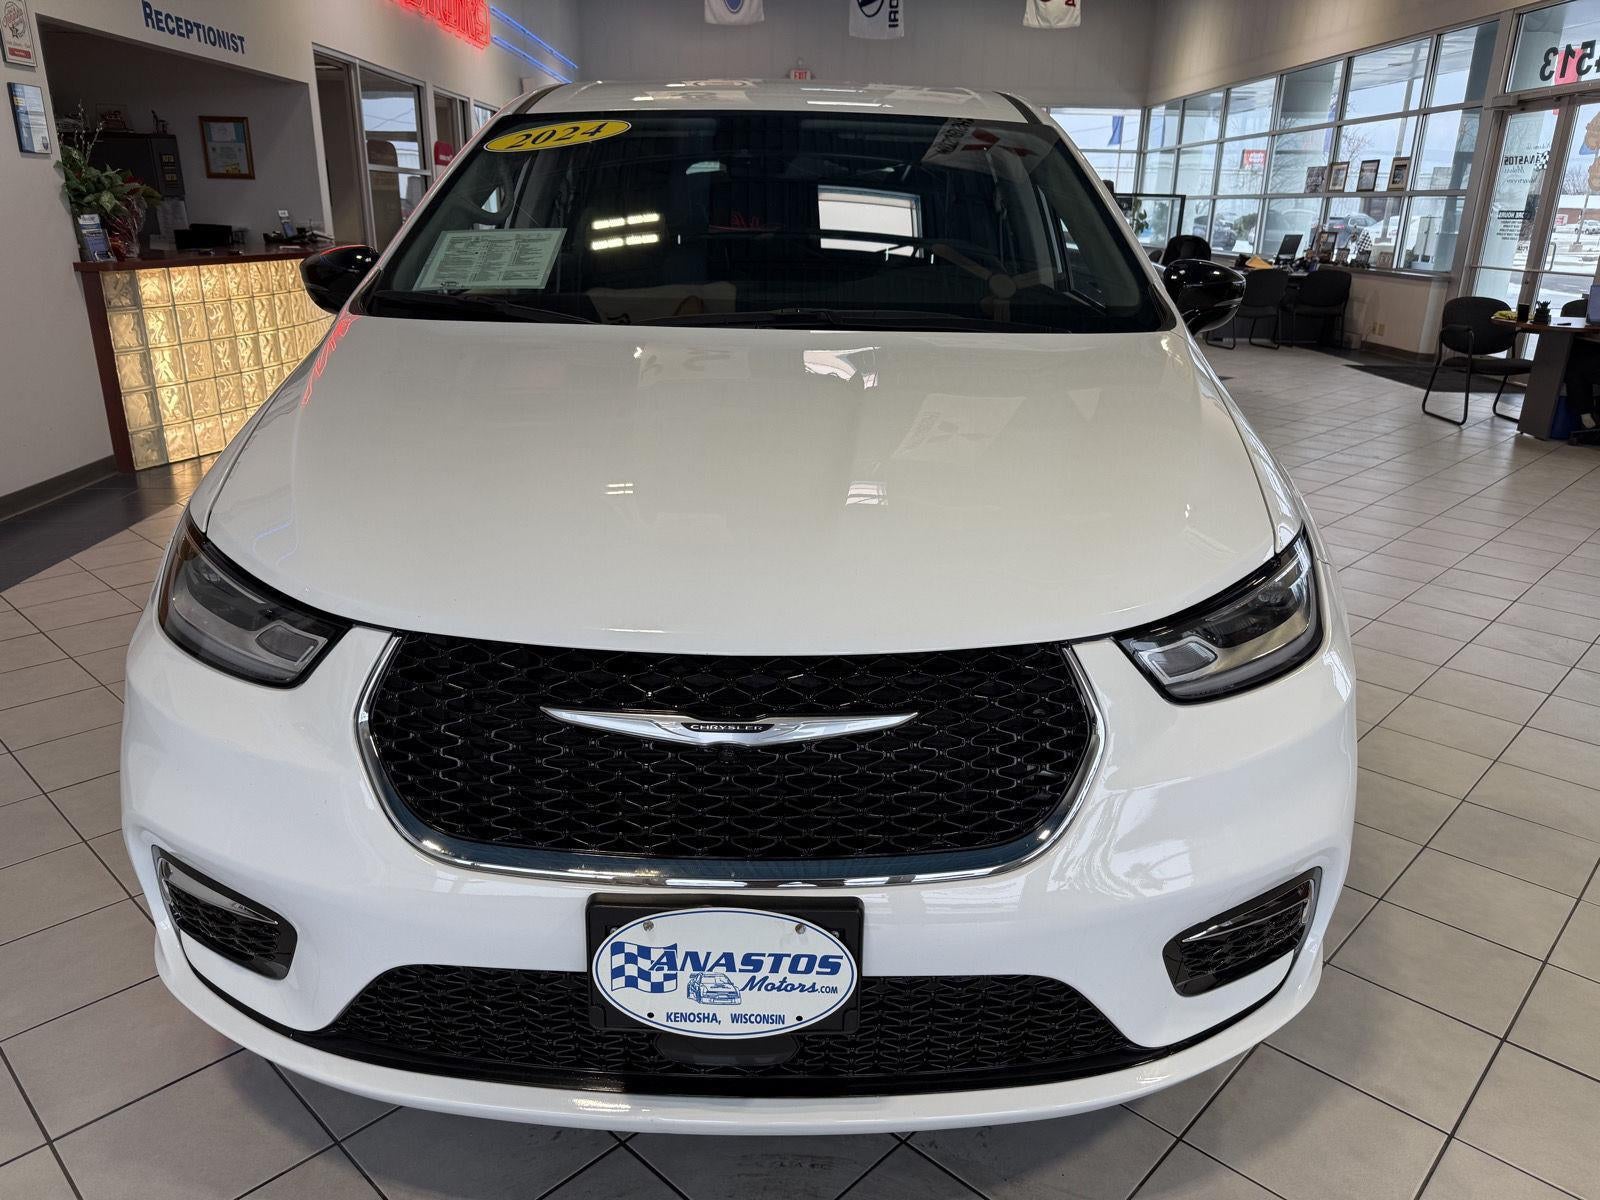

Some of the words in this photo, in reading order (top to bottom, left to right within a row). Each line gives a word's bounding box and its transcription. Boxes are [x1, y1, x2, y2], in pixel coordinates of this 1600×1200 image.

[141, 0, 245, 54] RECEPTIONIST
[793, 71, 807, 80] EXIT
[506, 122, 608, 149] 2024
[648, 950, 843, 975] ANASTOS
[666, 1012, 721, 1025] KENOSHA,
[731, 1013, 785, 1025] WISCONSIN
